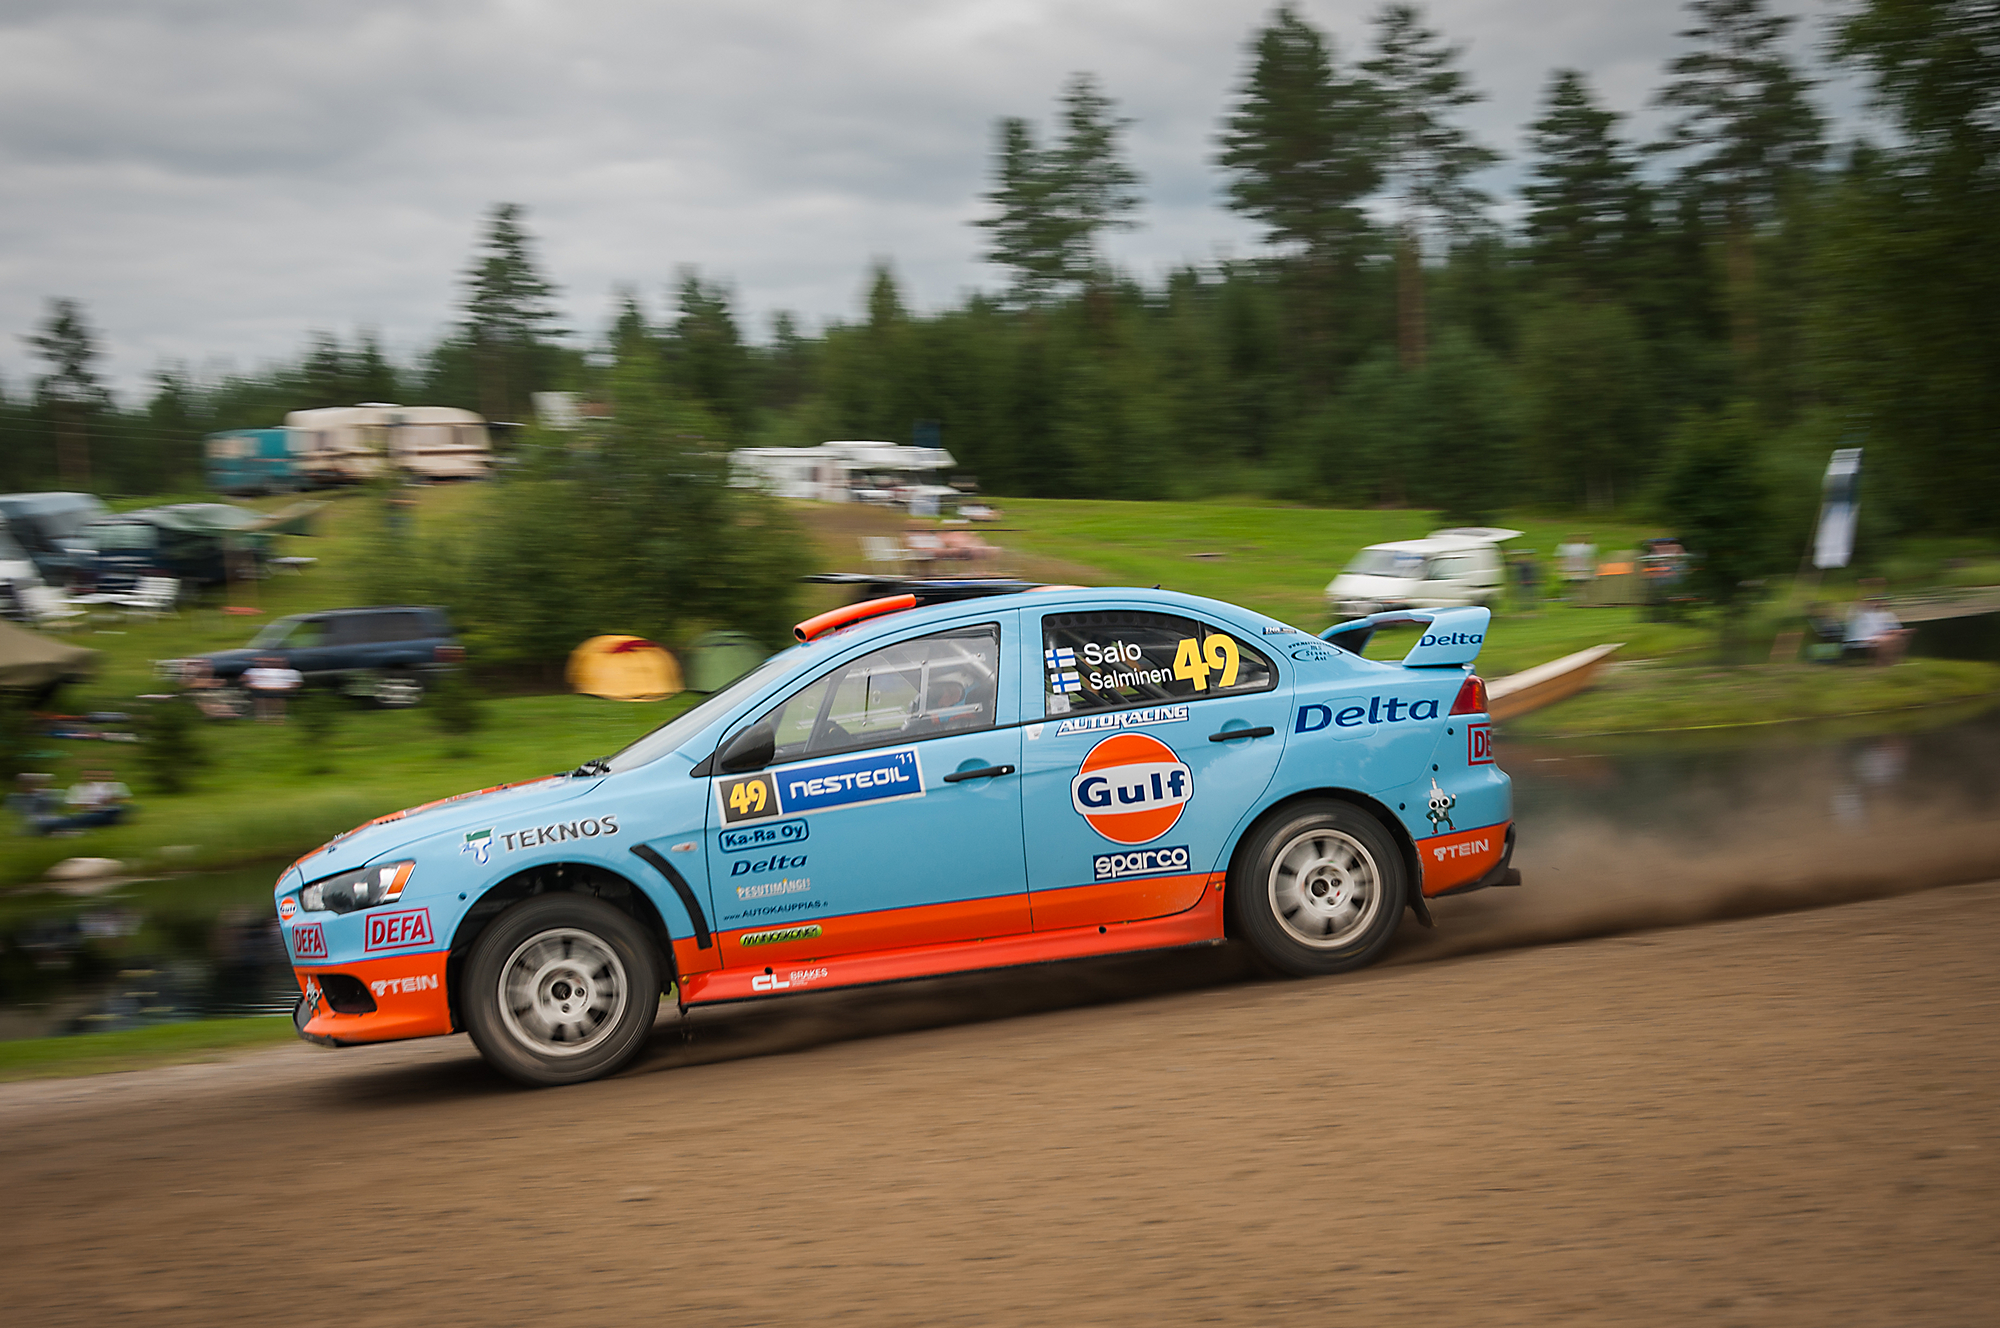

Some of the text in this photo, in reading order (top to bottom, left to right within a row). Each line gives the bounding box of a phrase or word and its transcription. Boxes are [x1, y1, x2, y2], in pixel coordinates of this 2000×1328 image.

[1083, 640, 1142, 666] Salo
[1420, 632, 1482, 647] Delta
[1173, 633, 1240, 692] 49
[1090, 667, 1173, 691] Salminen
[1056, 705, 1189, 736] AUTORACING
[1294, 696, 1440, 734] Delta
[729, 779, 767, 815] 49
[1077, 770, 1186, 808] Gulf
[500, 815, 619, 851] TEKNOS
[725, 823, 804, 848] Ka-Ra Oy
[730, 855, 808, 877] Delta
[1095, 848, 1188, 878] sparco
[295, 928, 322, 953] DEFA
[371, 913, 427, 945] DEFA
[752, 973, 790, 992] CL
[790, 967, 828, 980] BRAKES
